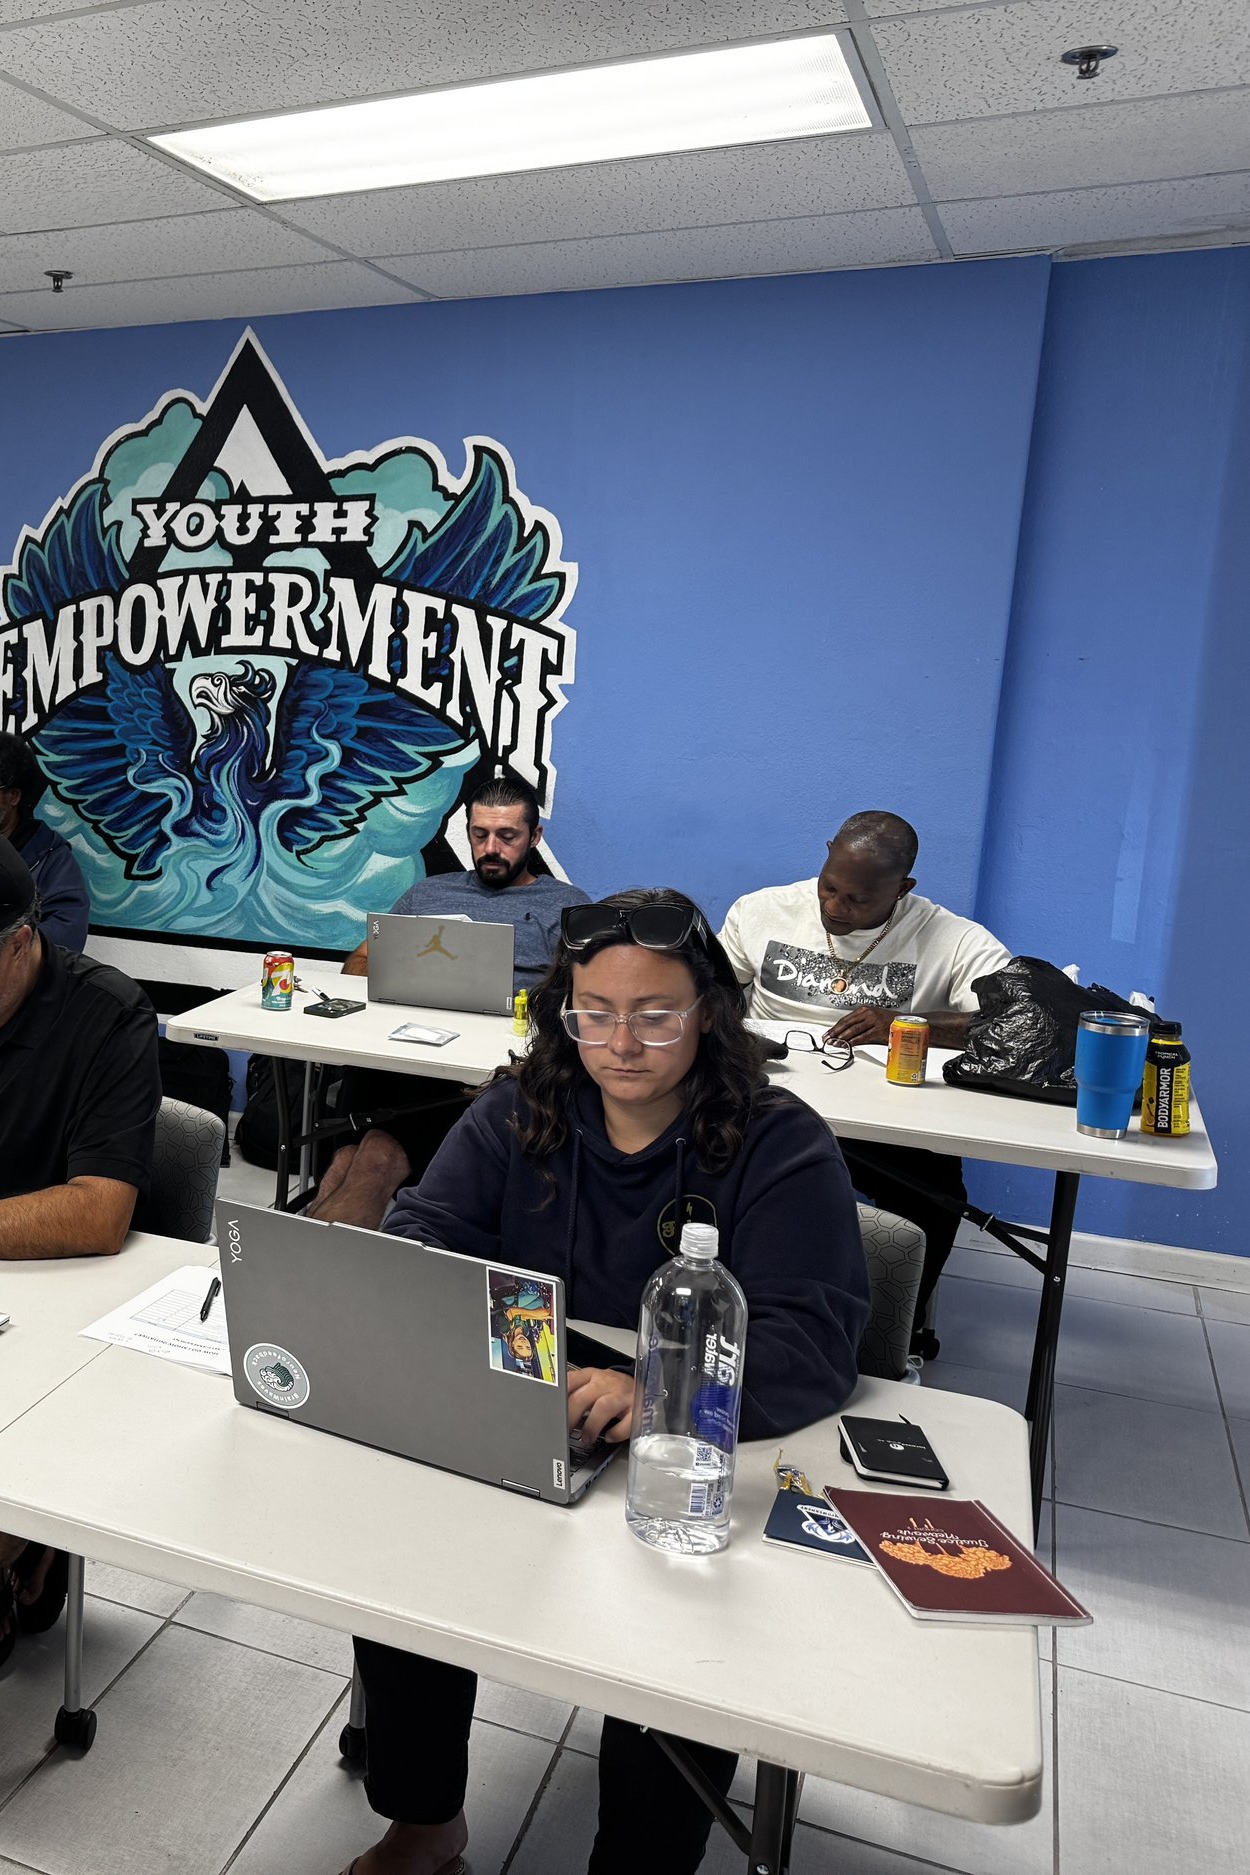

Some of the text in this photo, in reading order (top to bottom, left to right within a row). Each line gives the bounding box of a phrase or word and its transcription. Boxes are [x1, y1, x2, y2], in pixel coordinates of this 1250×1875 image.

[136, 500, 372, 547] YOUTH
[773, 959, 899, 999] Diamnd
[1157, 1067, 1171, 1128] BODYARMOR
[228, 1220, 242, 1263] YOGA
[252, 1351, 301, 1380] Neurofeedback
[880, 1531, 989, 1548] Justice Serving
[897, 1529, 960, 1540] Network
